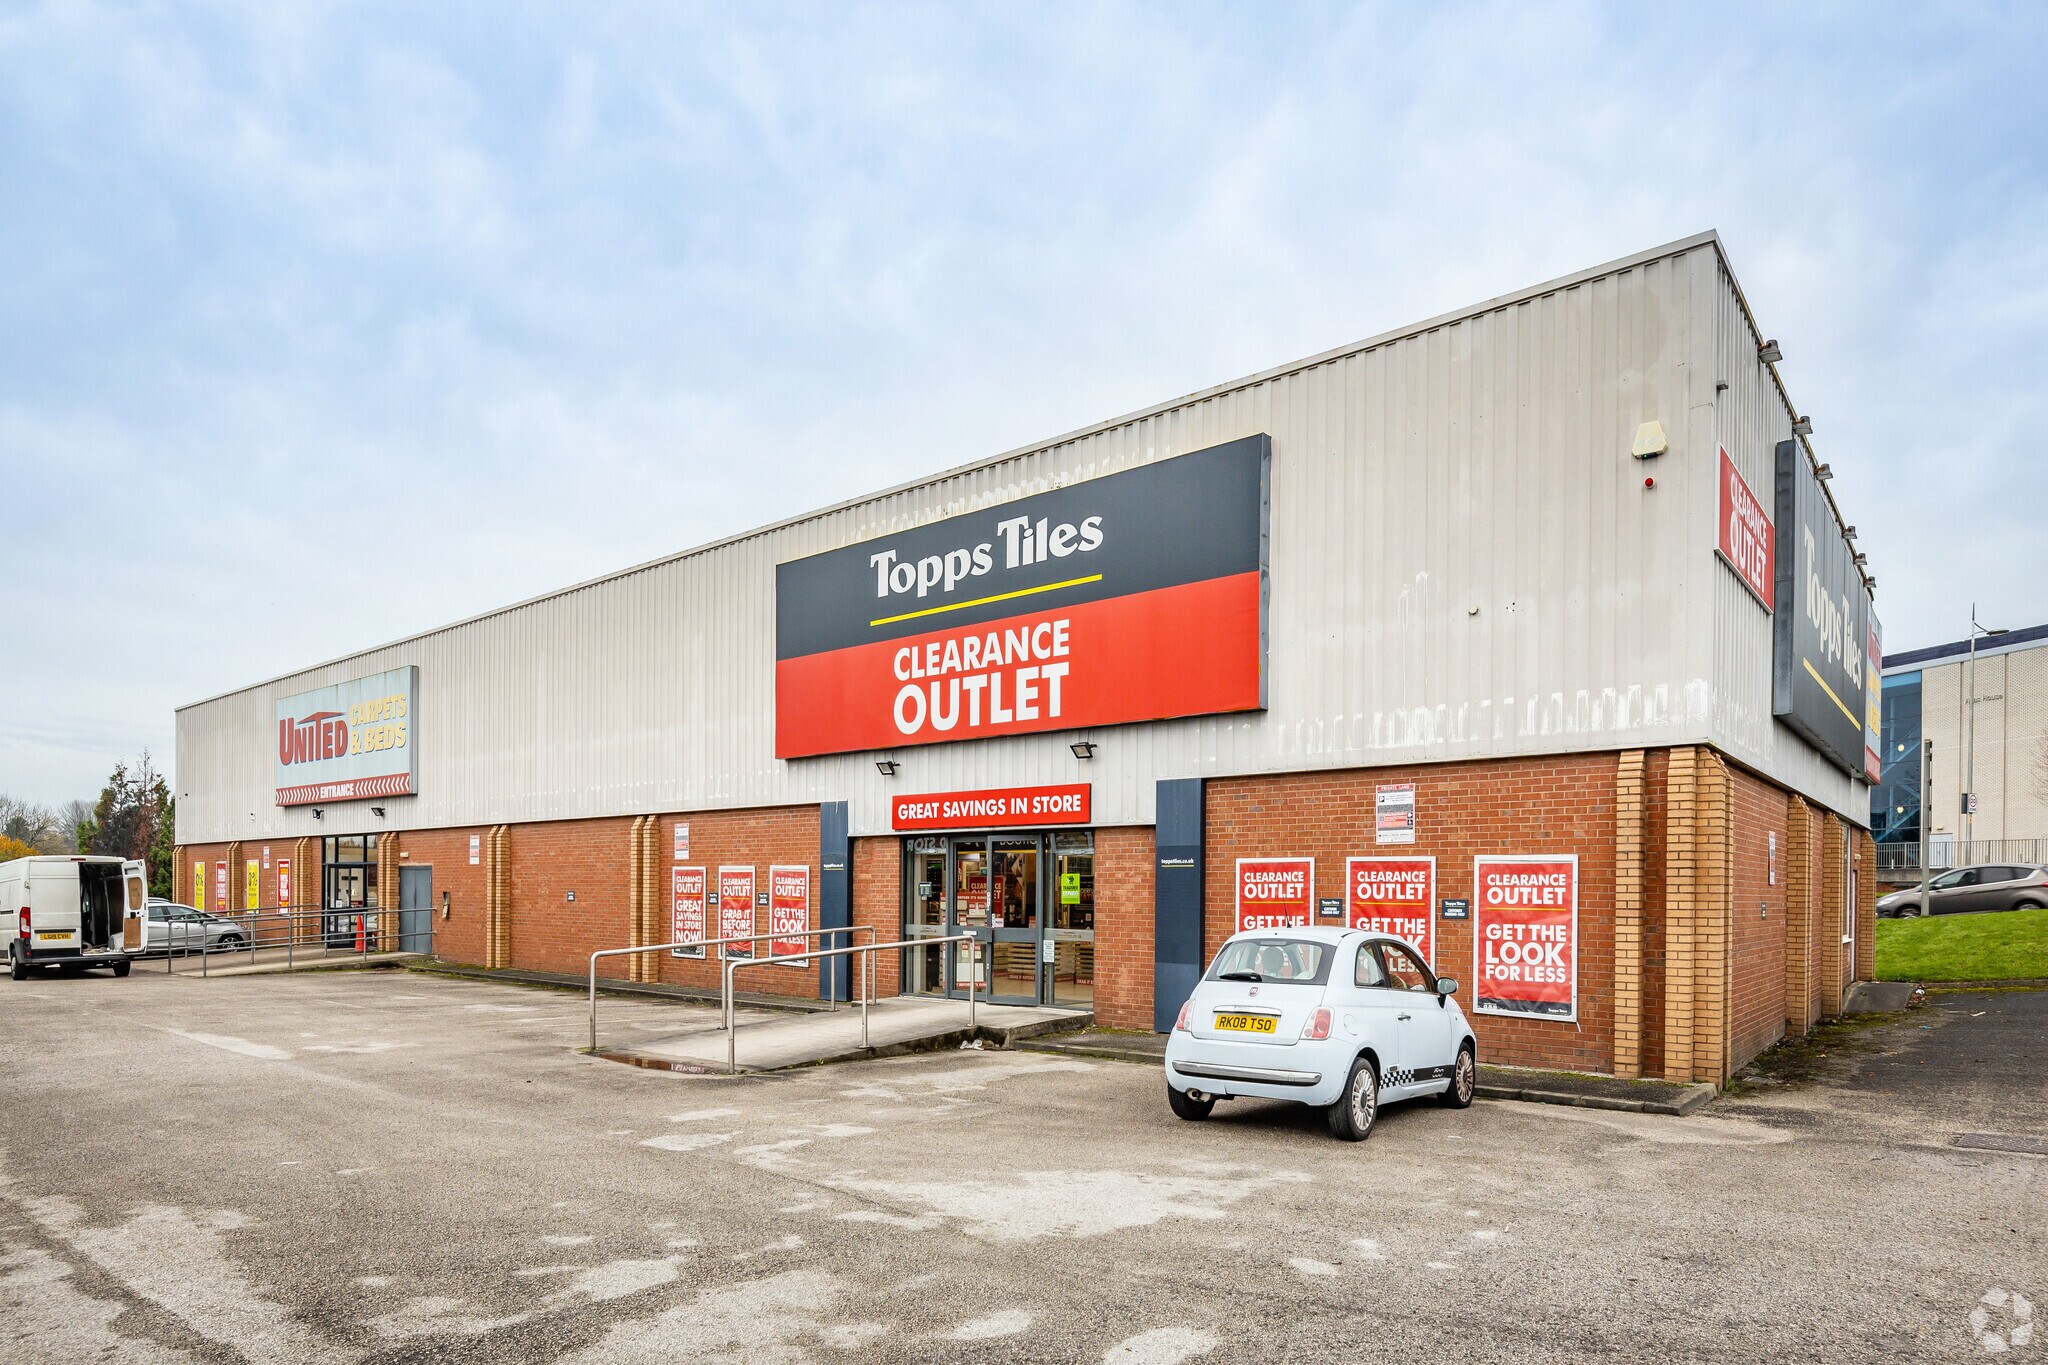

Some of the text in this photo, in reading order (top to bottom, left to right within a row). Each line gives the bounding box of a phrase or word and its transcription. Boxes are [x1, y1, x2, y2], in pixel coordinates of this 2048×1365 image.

[1730, 473, 1767, 548] CLEARANCE
[870, 515, 1104, 598] Topps Tiles
[1730, 510, 1766, 593] OUTLET
[1804, 523, 1862, 691] Topps Tiles
[893, 618, 1070, 681] CLEARANCE
[893, 662, 1070, 735] OUTLET
[349, 693, 407, 727] CARPETS
[350, 722, 407, 755] & BEDS
[320, 783, 354, 798] ENTRANCE
[897, 794, 1082, 820] GREAT SAVINGS IN STORE
[775, 877, 805, 885] CLEARANCE
[1244, 871, 1304, 883] CLEARANCE
[1357, 871, 1425, 882] CLEARANCE
[1487, 874, 1566, 886] CLEARANCE
[676, 883, 702, 893] OUTLET
[723, 885, 750, 896] OUTLET
[775, 884, 805, 897] OUTLET
[1244, 883, 1304, 899] OUTLET
[1356, 883, 1425, 900] OUTLET
[1487, 886, 1566, 905] OUTLET
[676, 900, 702, 912] GREAT
[774, 907, 805, 919] GET THE
[676, 912, 702, 920] SAVINGS
[722, 909, 751, 919] GRAB IT
[676, 920, 702, 930] IN STORE
[722, 919, 750, 930] BEFORE
[774, 917, 804, 933] LOOK
[1243, 915, 1305, 930] GET THE
[1356, 917, 1425, 934] GET THE
[676, 929, 702, 943] NOW!
[722, 929, 732, 938] IT'S
[1486, 923, 1567, 942] GET THE
[1485, 940, 1565, 967] LOOK
[1389, 958, 1420, 973] LES
[1485, 964, 1566, 983] FOR LESS
[1219, 1016, 1247, 1029] RK08
